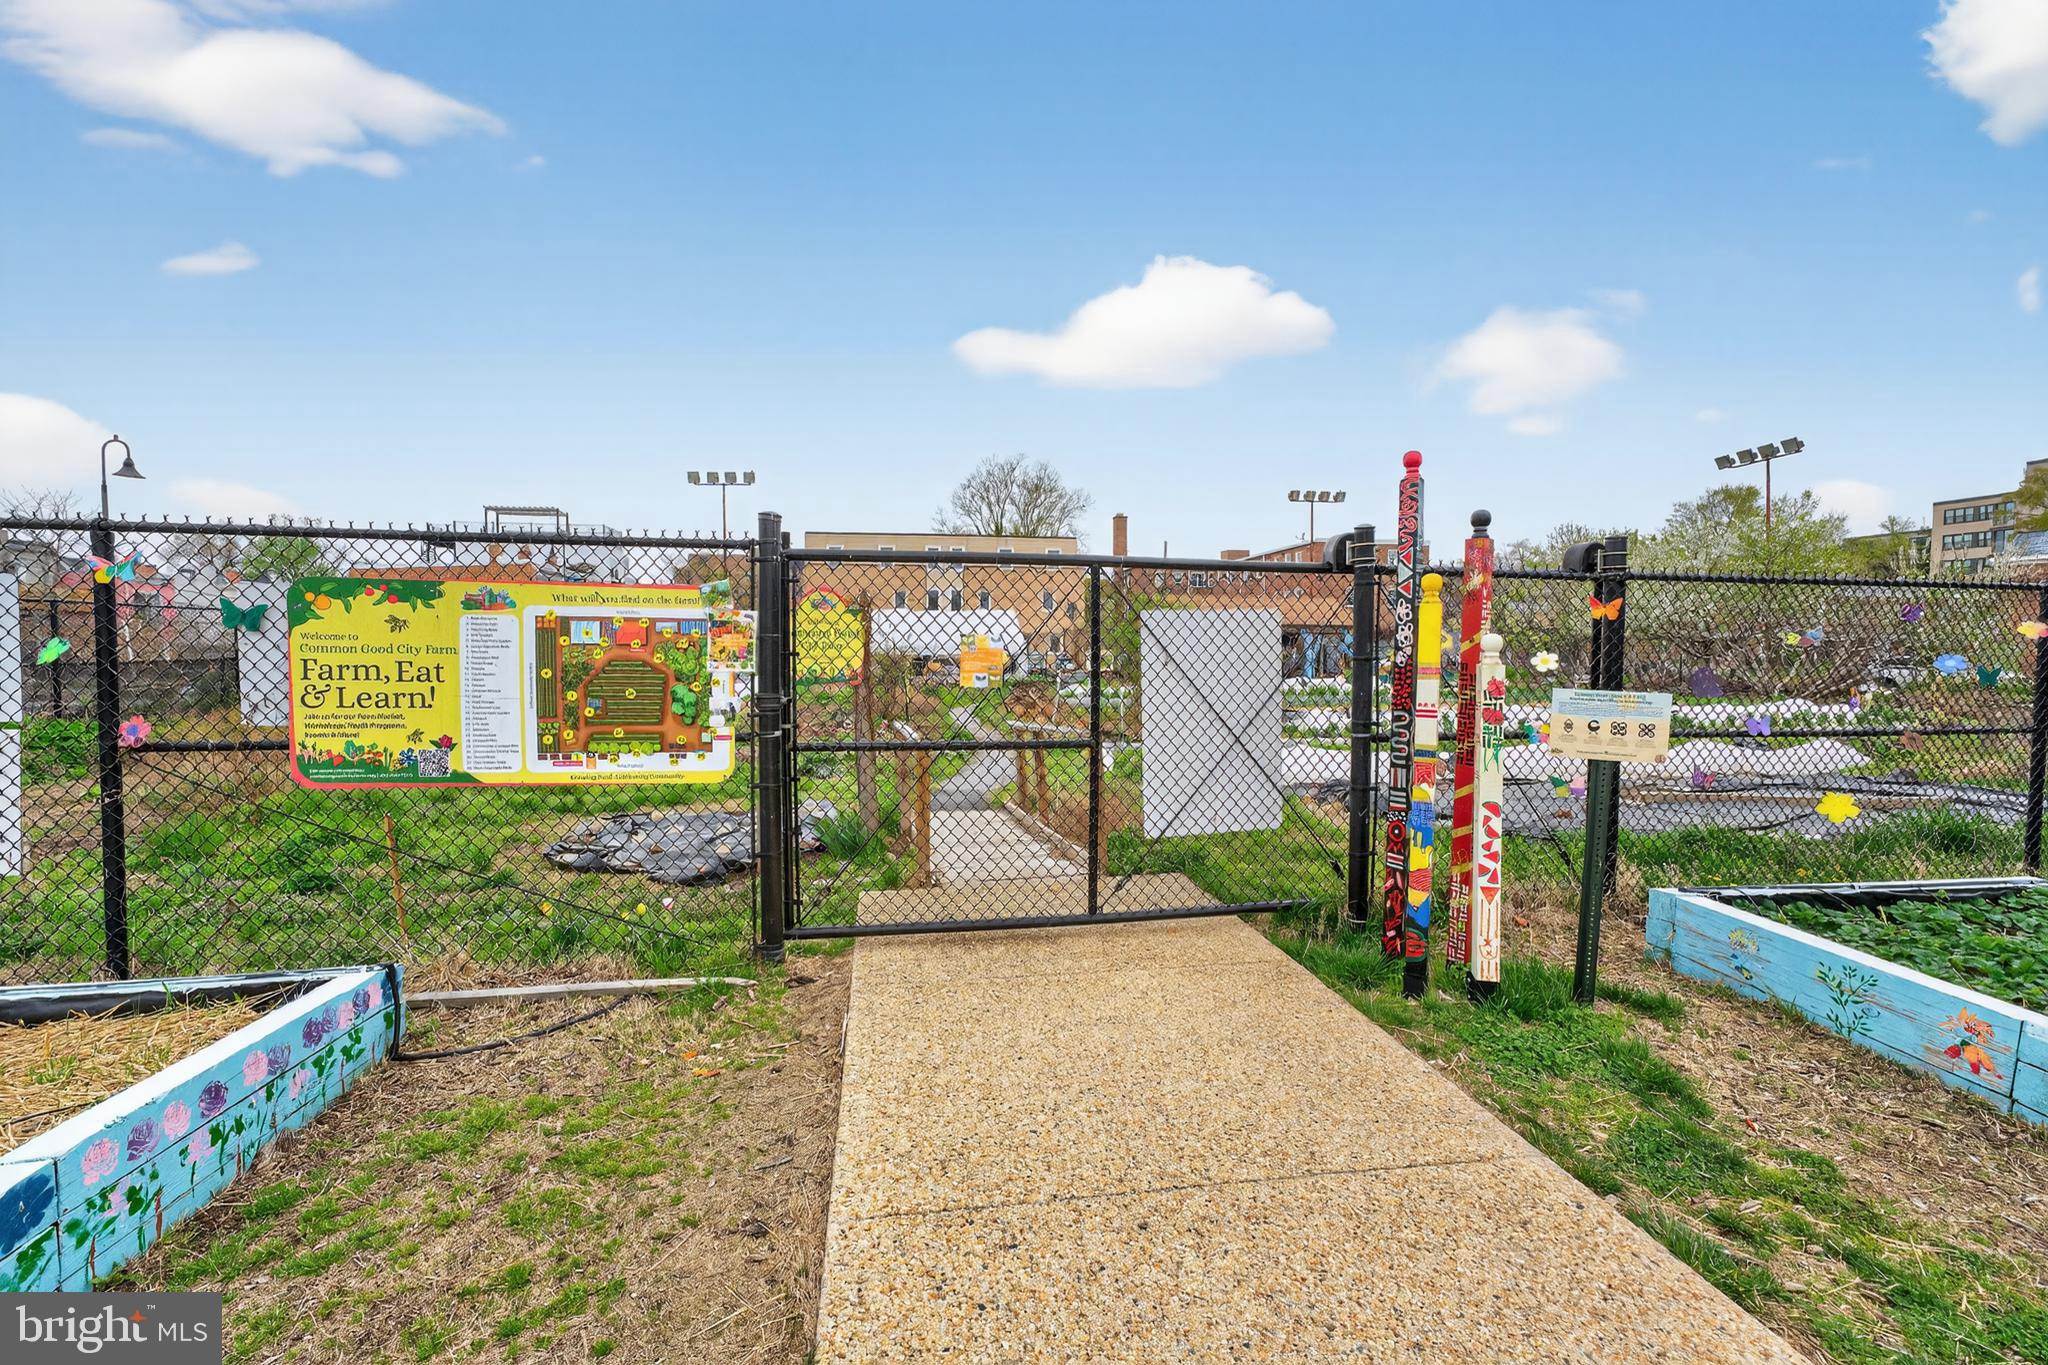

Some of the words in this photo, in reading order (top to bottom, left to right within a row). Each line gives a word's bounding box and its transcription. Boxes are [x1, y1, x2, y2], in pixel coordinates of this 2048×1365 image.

[300, 632, 347, 641] Welcome
[348, 633, 358, 641] to
[299, 643, 357, 654] Common
[361, 643, 393, 654] Good
[397, 644, 422, 657] City
[426, 645, 458, 655] Farm
[300, 658, 391, 684] Farm,
[395, 660, 446, 683] Eat
[300, 683, 332, 709] &
[336, 686, 436, 709] Learn!
